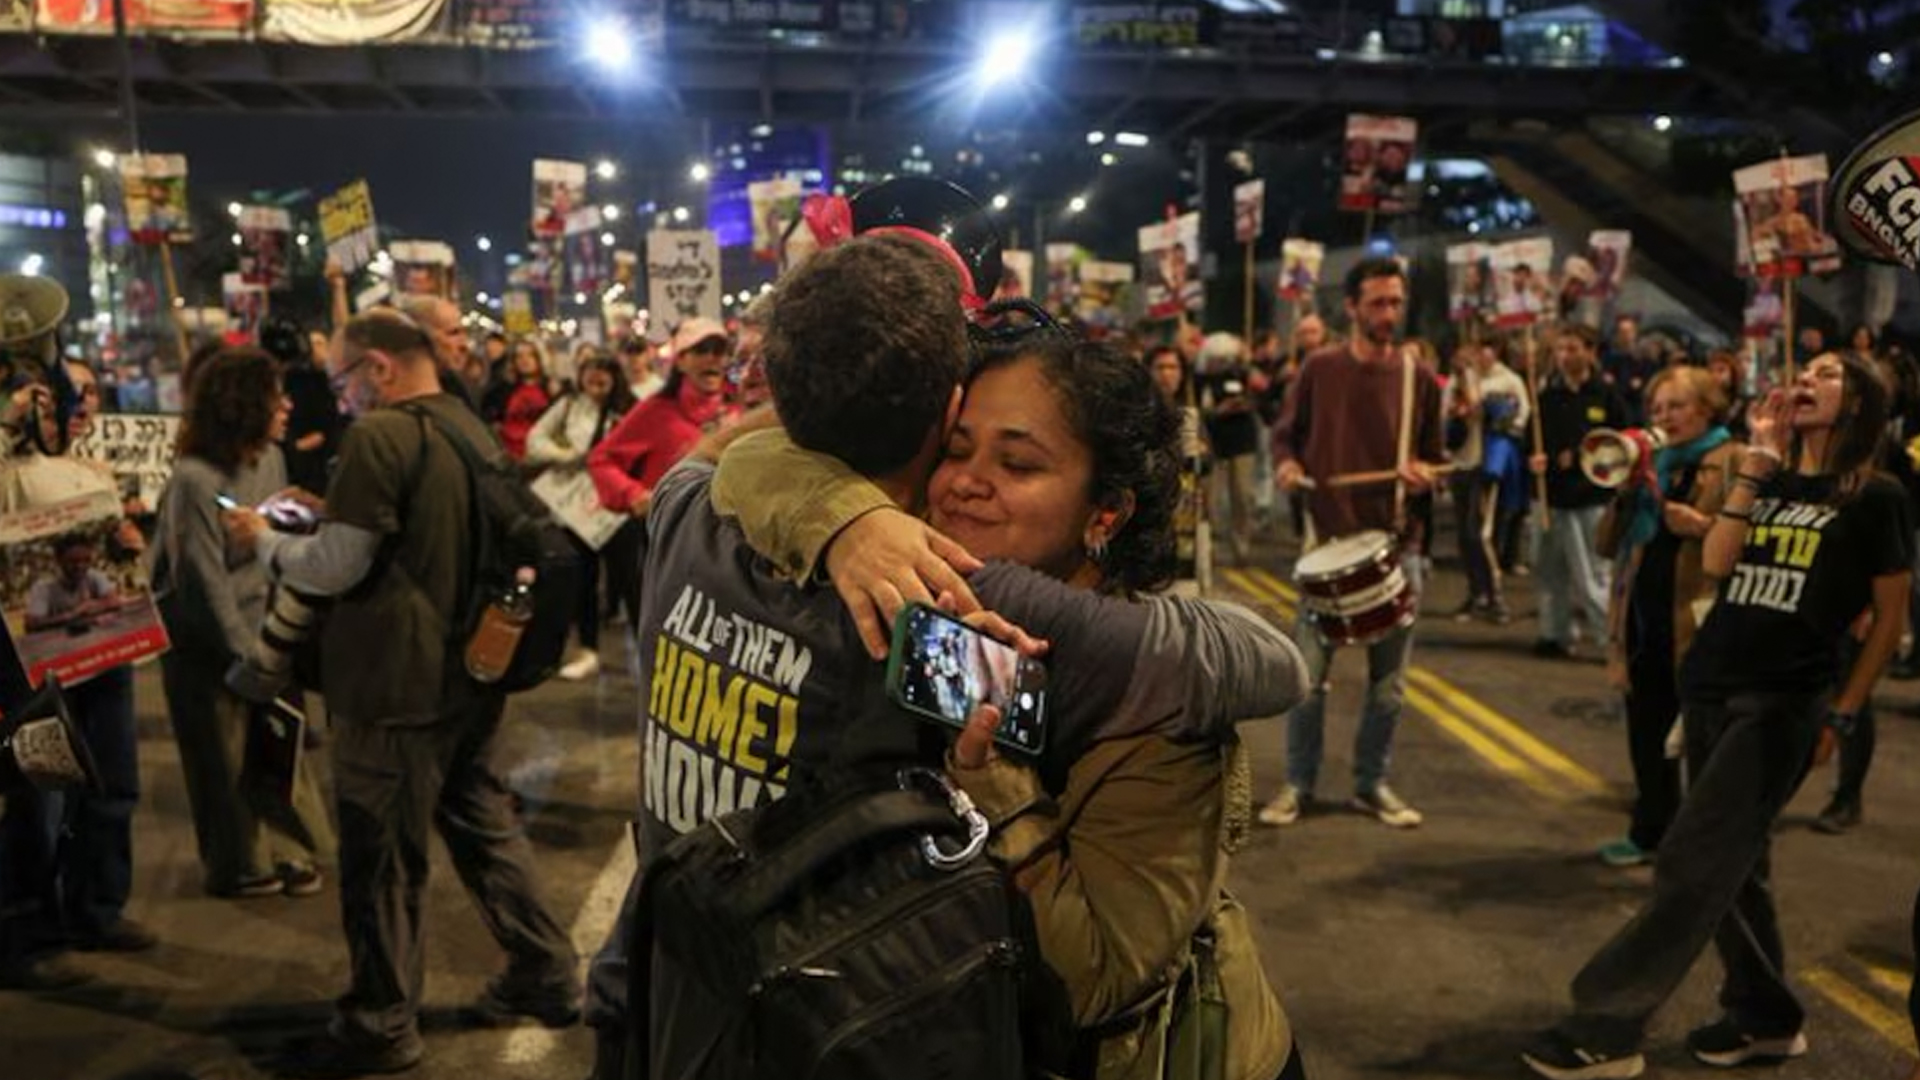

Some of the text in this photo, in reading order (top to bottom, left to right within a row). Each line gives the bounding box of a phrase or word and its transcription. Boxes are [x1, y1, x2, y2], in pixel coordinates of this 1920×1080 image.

[663, 584, 814, 696] ALL OF THEM
[649, 634, 799, 780] HOME!
